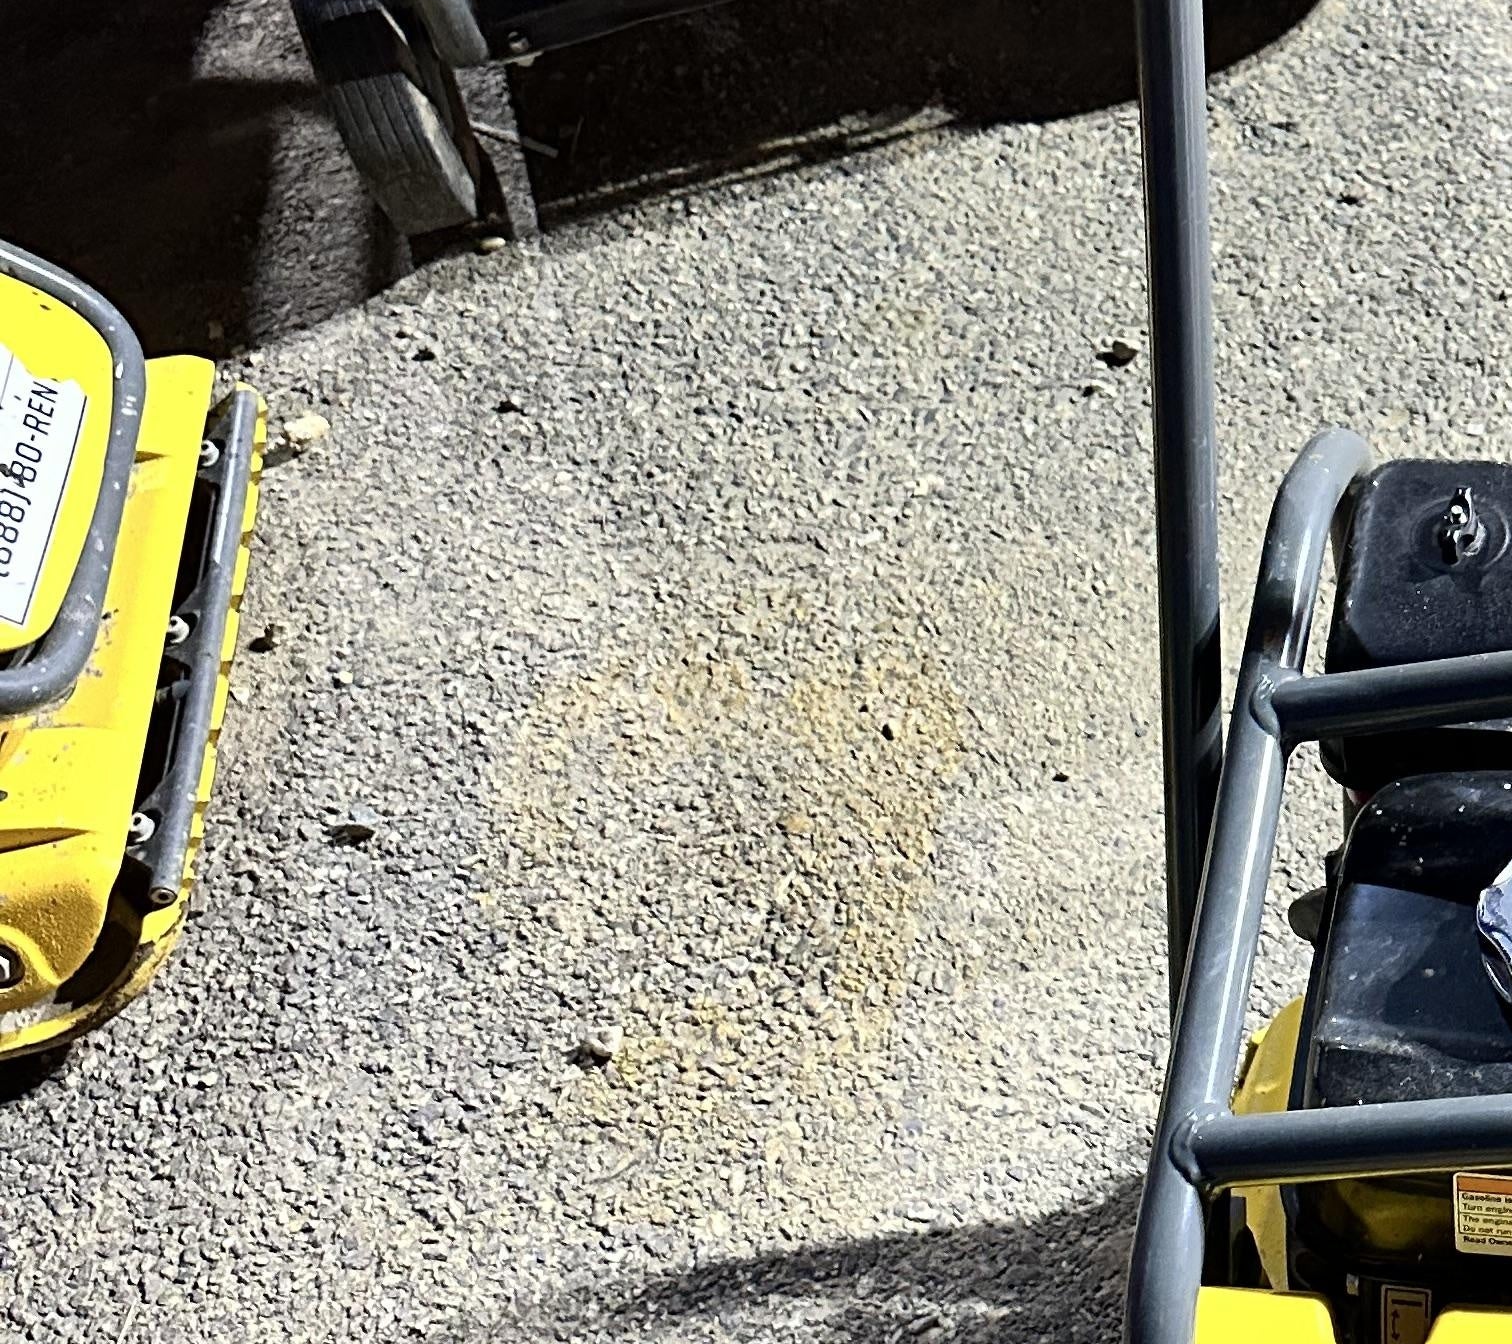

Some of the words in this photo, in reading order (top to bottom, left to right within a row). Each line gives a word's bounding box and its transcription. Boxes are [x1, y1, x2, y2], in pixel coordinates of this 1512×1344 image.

[1462, 1193, 1502, 1203] Gasoline
[1462, 1203, 1483, 1212] Turn
[1462, 1215, 1480, 1223] The
[1463, 1225, 1476, 1233] Do
[1463, 1236, 1487, 1244] Read
